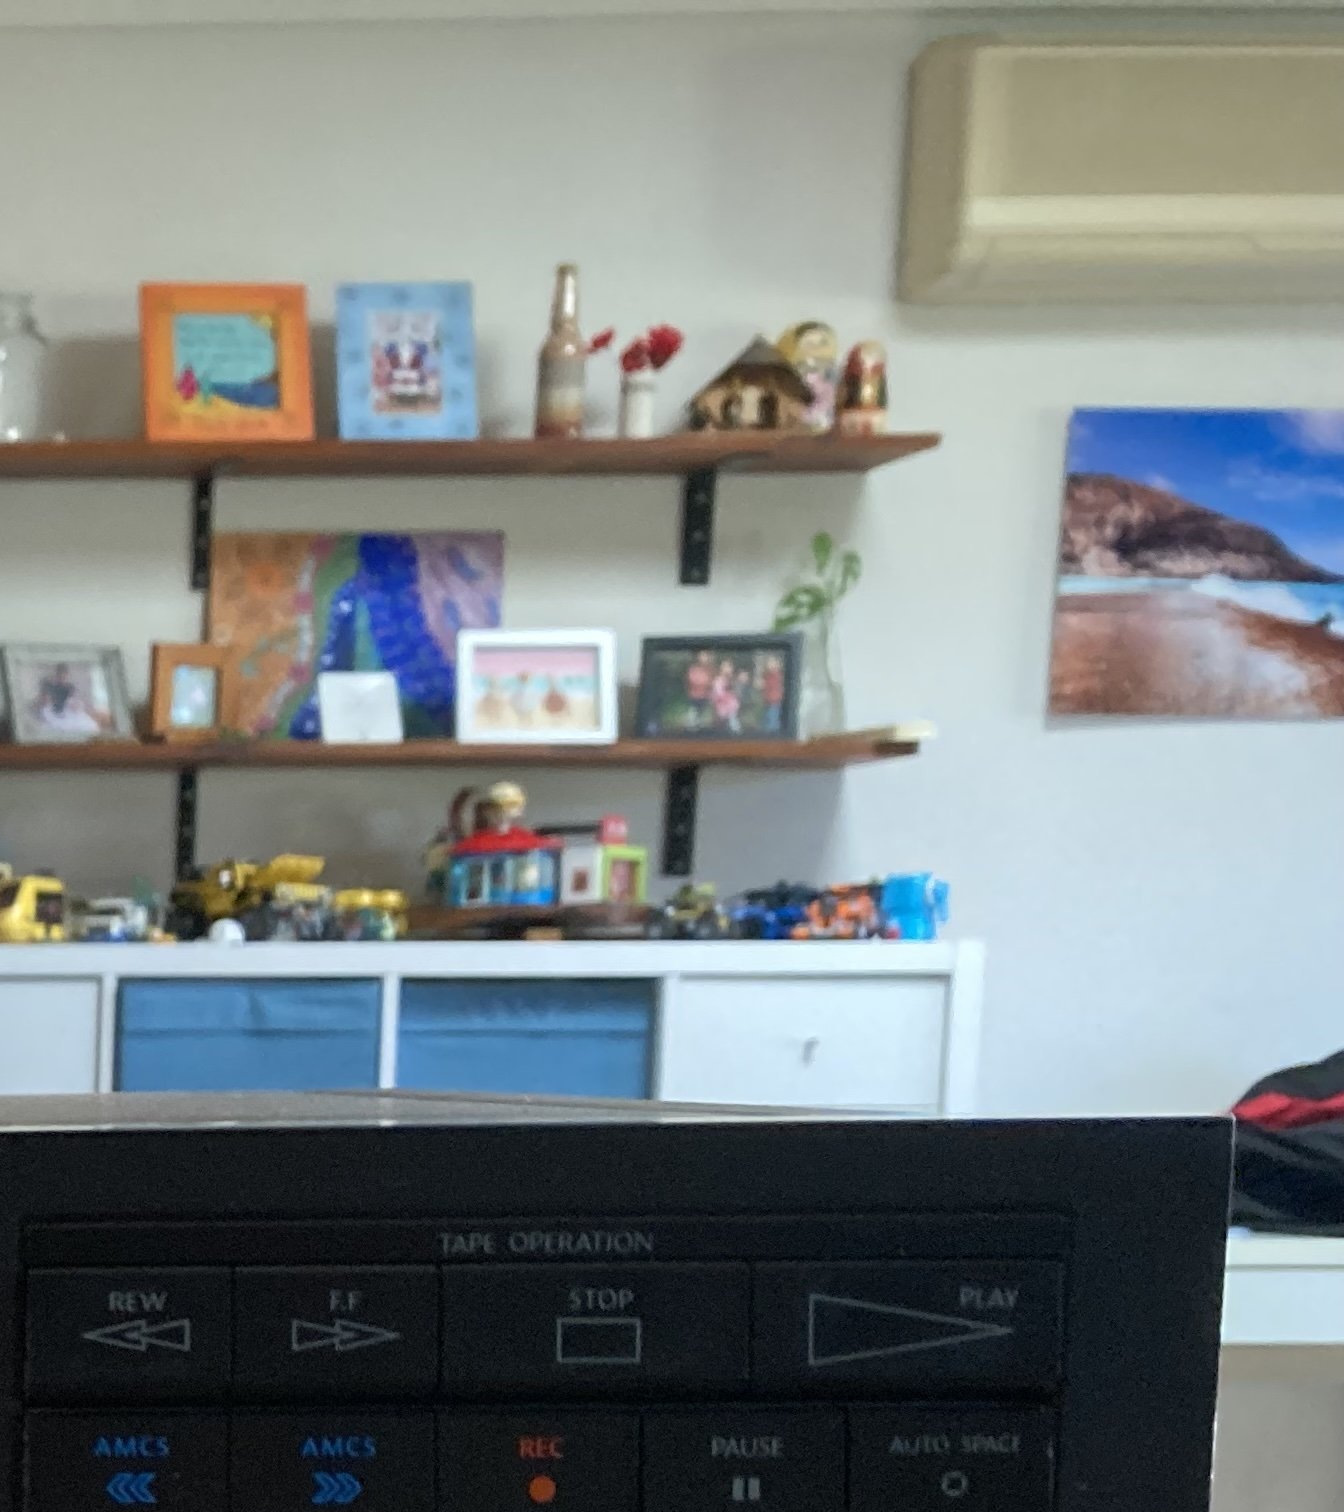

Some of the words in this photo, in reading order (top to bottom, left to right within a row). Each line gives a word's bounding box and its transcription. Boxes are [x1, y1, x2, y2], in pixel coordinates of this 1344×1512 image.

[438, 1231, 496, 1256] TAPE
[507, 1230, 655, 1255] OPERATION
[106, 1289, 169, 1313] REW
[568, 1286, 636, 1311] STOP
[957, 1283, 1023, 1310] PLAY
[91, 1434, 171, 1459] AMCS
[299, 1434, 378, 1459] AMCS
[518, 1434, 565, 1459] REC
[711, 1434, 785, 1459] PAUSE
[887, 1433, 951, 1456] AUTO
[960, 1432, 1023, 1455] SPACE
